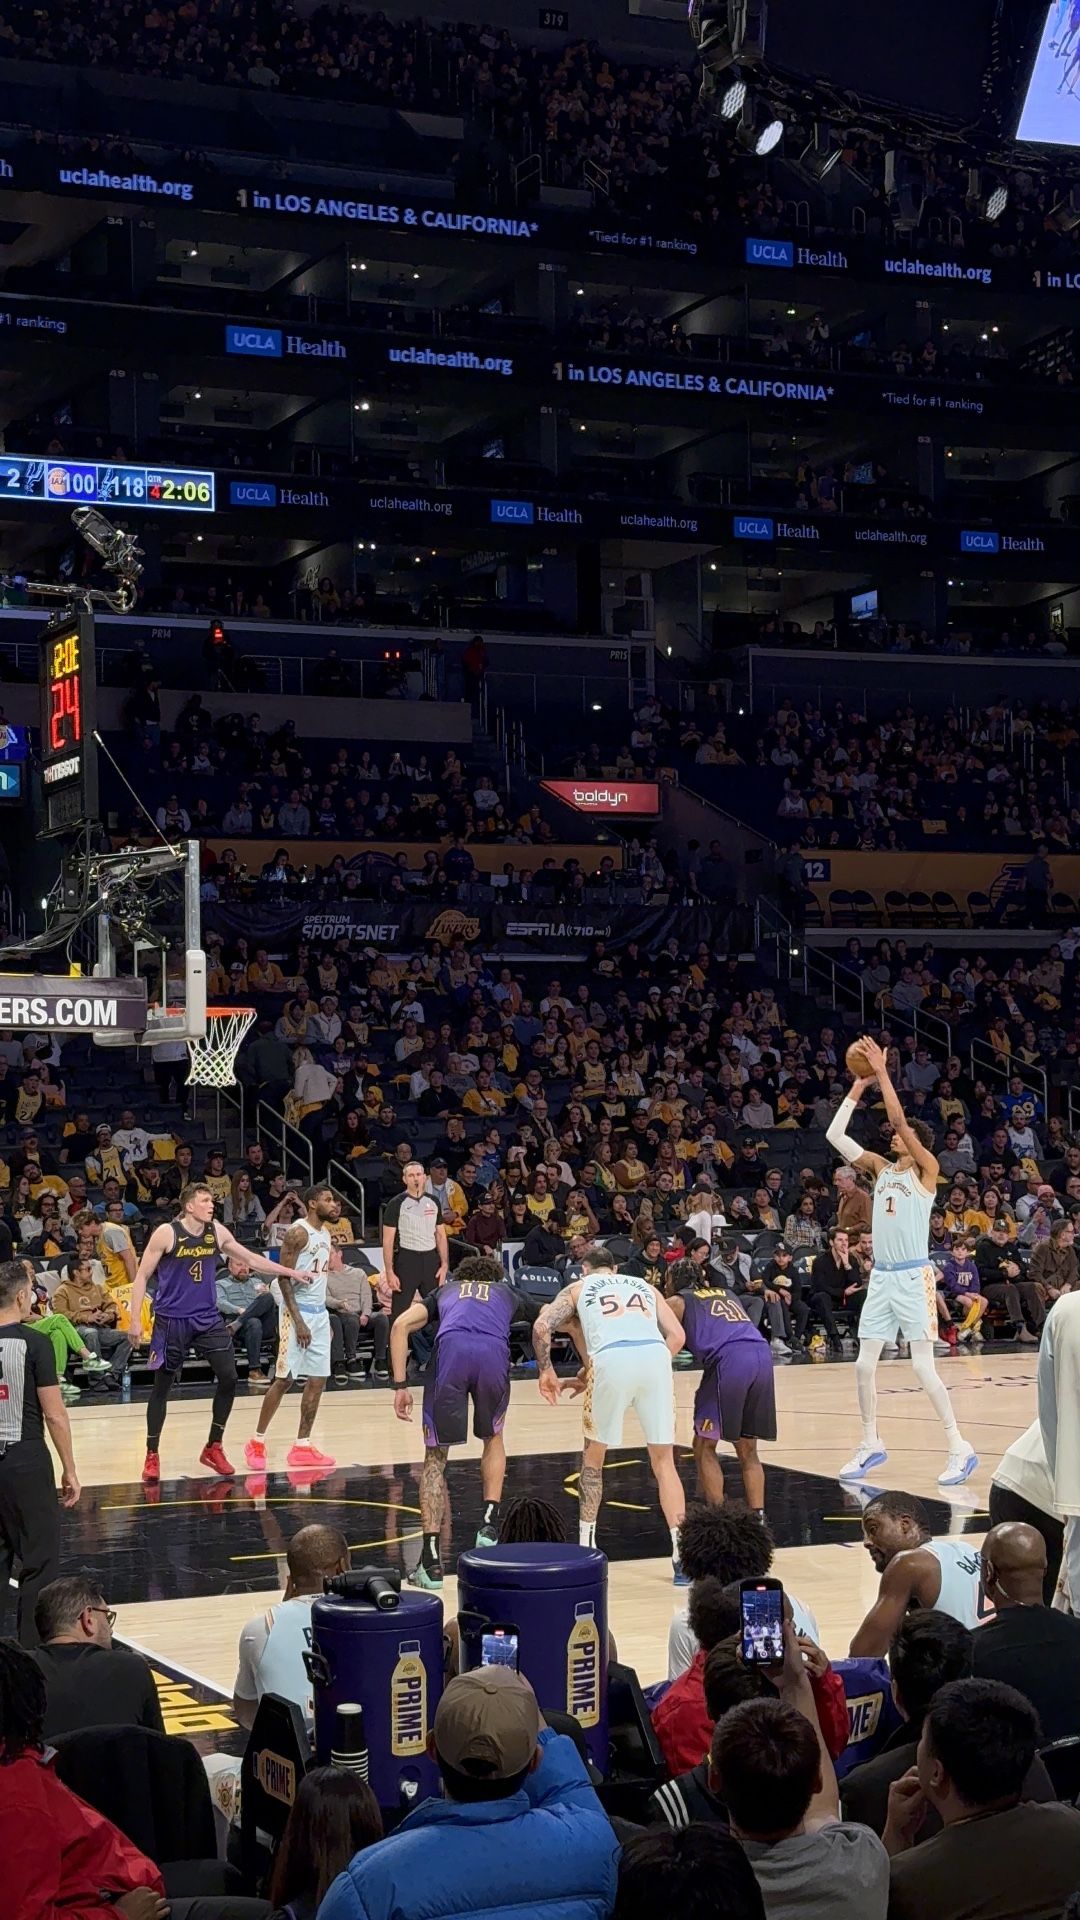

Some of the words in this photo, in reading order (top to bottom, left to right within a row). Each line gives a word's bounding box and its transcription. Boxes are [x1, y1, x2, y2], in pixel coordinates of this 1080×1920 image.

[544, 12, 564, 27] 319
[59, 167, 194, 200] uclahealth.org
[253, 190, 271, 209] in
[274, 193, 311, 214] LOS
[314, 198, 399, 223] ANGELES
[403, 207, 417, 226] &
[621, 232, 637, 246] for
[639, 235, 653, 248] #1
[655, 238, 697, 254] ranking
[752, 244, 788, 262] UCLA
[797, 247, 848, 269] Health
[884, 257, 992, 284] uclahealth.org
[1047, 271, 1062, 288] in
[16, 315, 67, 334] ranking
[233, 332, 275, 350] UCLA
[286, 336, 347, 358] Health
[388, 347, 513, 376] uclahealth.org
[568, 364, 585, 381] in
[588, 366, 622, 384] LOS
[625, 370, 705, 391] ANGELES
[708, 376, 721, 392] &
[912, 394, 927, 407] for
[929, 397, 941, 408] #1
[945, 398, 984, 414] ranking
[7, 468, 20, 488] 2
[64, 473, 95, 494] 100
[113, 476, 144, 498] 118
[148, 475, 162, 484] QTR
[151, 485, 161, 499] 4
[162, 480, 211, 502] 2:06
[236, 488, 270, 501] UCLA
[280, 489, 329, 507] Health
[369, 497, 453, 515] uclahealth.org
[496, 506, 529, 519] UCLA
[537, 507, 583, 525] Health
[620, 514, 698, 532] uclahealth.org
[738, 522, 769, 535] UCLA
[777, 523, 820, 540] Health
[855, 529, 928, 546] uclahealth.org
[965, 536, 994, 549] UCLA
[1001, 536, 1045, 551] Health
[52, 675, 80, 749] 24
[52, 756, 80, 782] TISSOT
[573, 789, 628, 806] boldyn
[804, 862, 825, 879] 12
[304, 915, 350, 924] SPECTRUM
[430, 920, 479, 937] LAKERS
[302, 924, 400, 941] SPORTSNET
[0, 998, 118, 1027] ERS.COM
[885, 1196, 895, 1214] 1
[189, 1260, 203, 1282] 4
[530, 1274, 559, 1283] DELTA
[459, 1282, 490, 1302] 11
[599, 1293, 649, 1317] 54
[711, 1300, 751, 1323] 41
[573, 1641, 595, 1716] PRIME
[397, 1676, 422, 1744] PRIME
[265, 1756, 290, 1799] PRIME
